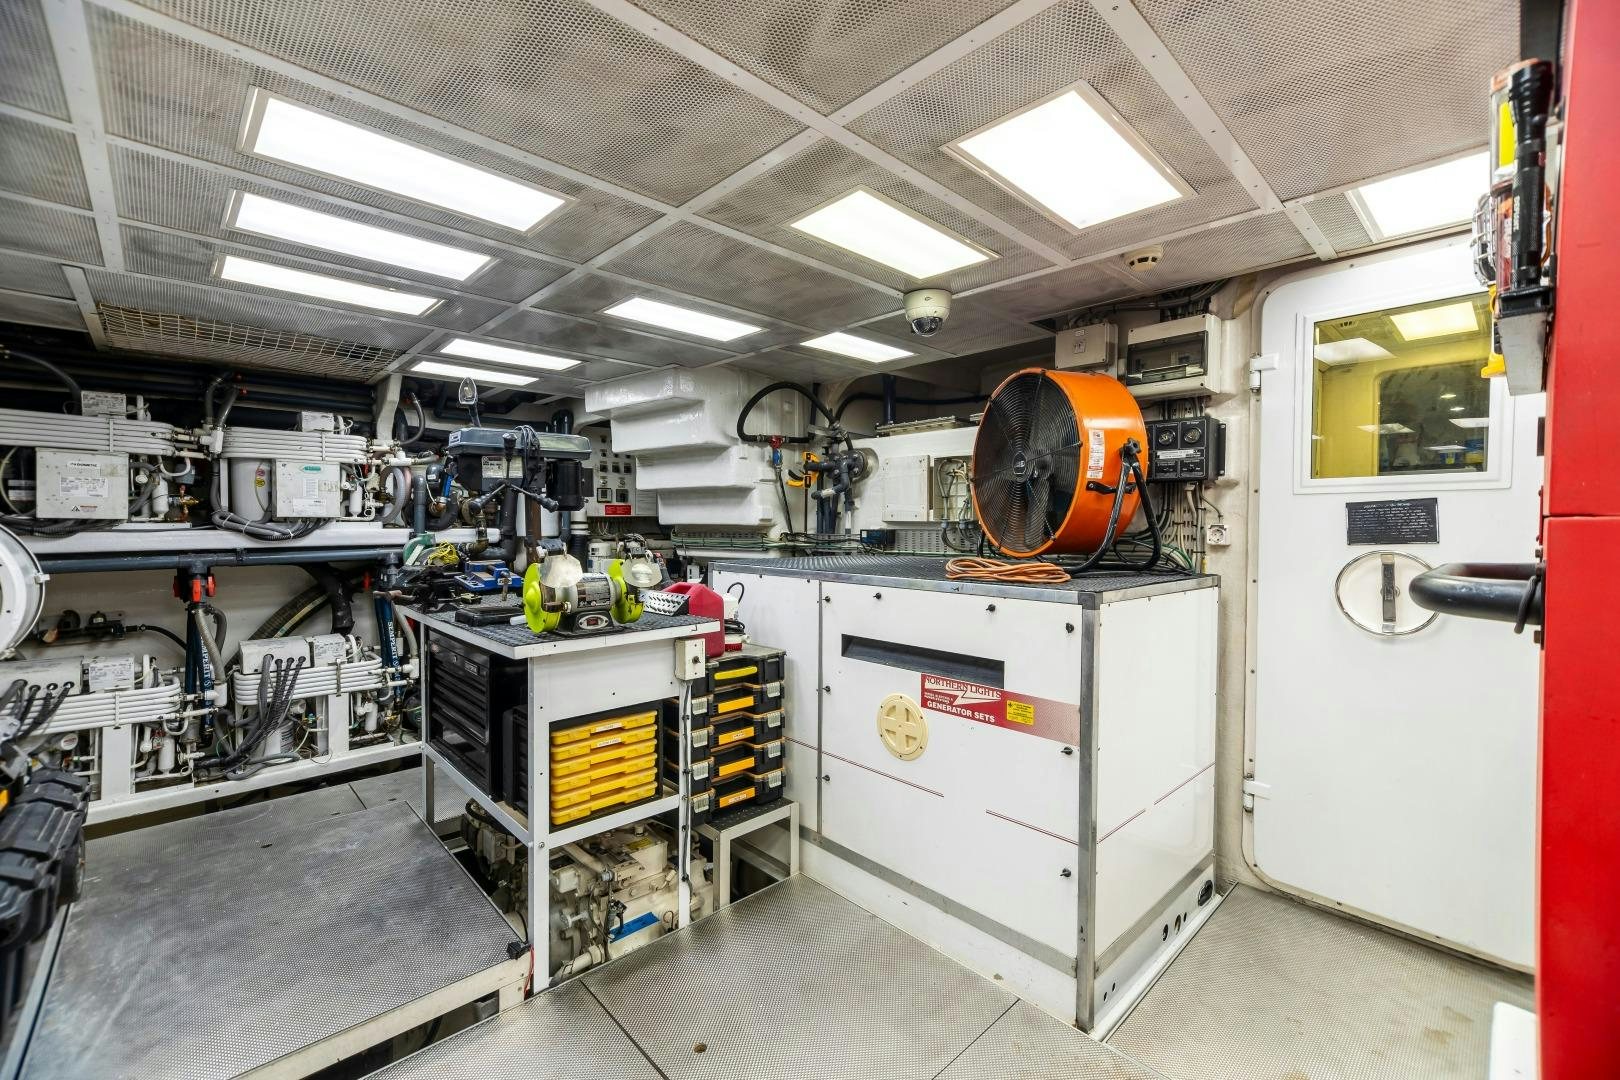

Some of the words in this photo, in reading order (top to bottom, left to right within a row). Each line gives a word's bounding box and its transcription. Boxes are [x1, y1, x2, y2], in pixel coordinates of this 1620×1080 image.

[388, 621, 398, 660] SEMPERIT
[200, 635, 211, 680] MPERIT
[970, 686, 1002, 699] LIGHTS
[927, 701, 973, 717] GENERATOR
[974, 712, 996, 723] SETS
